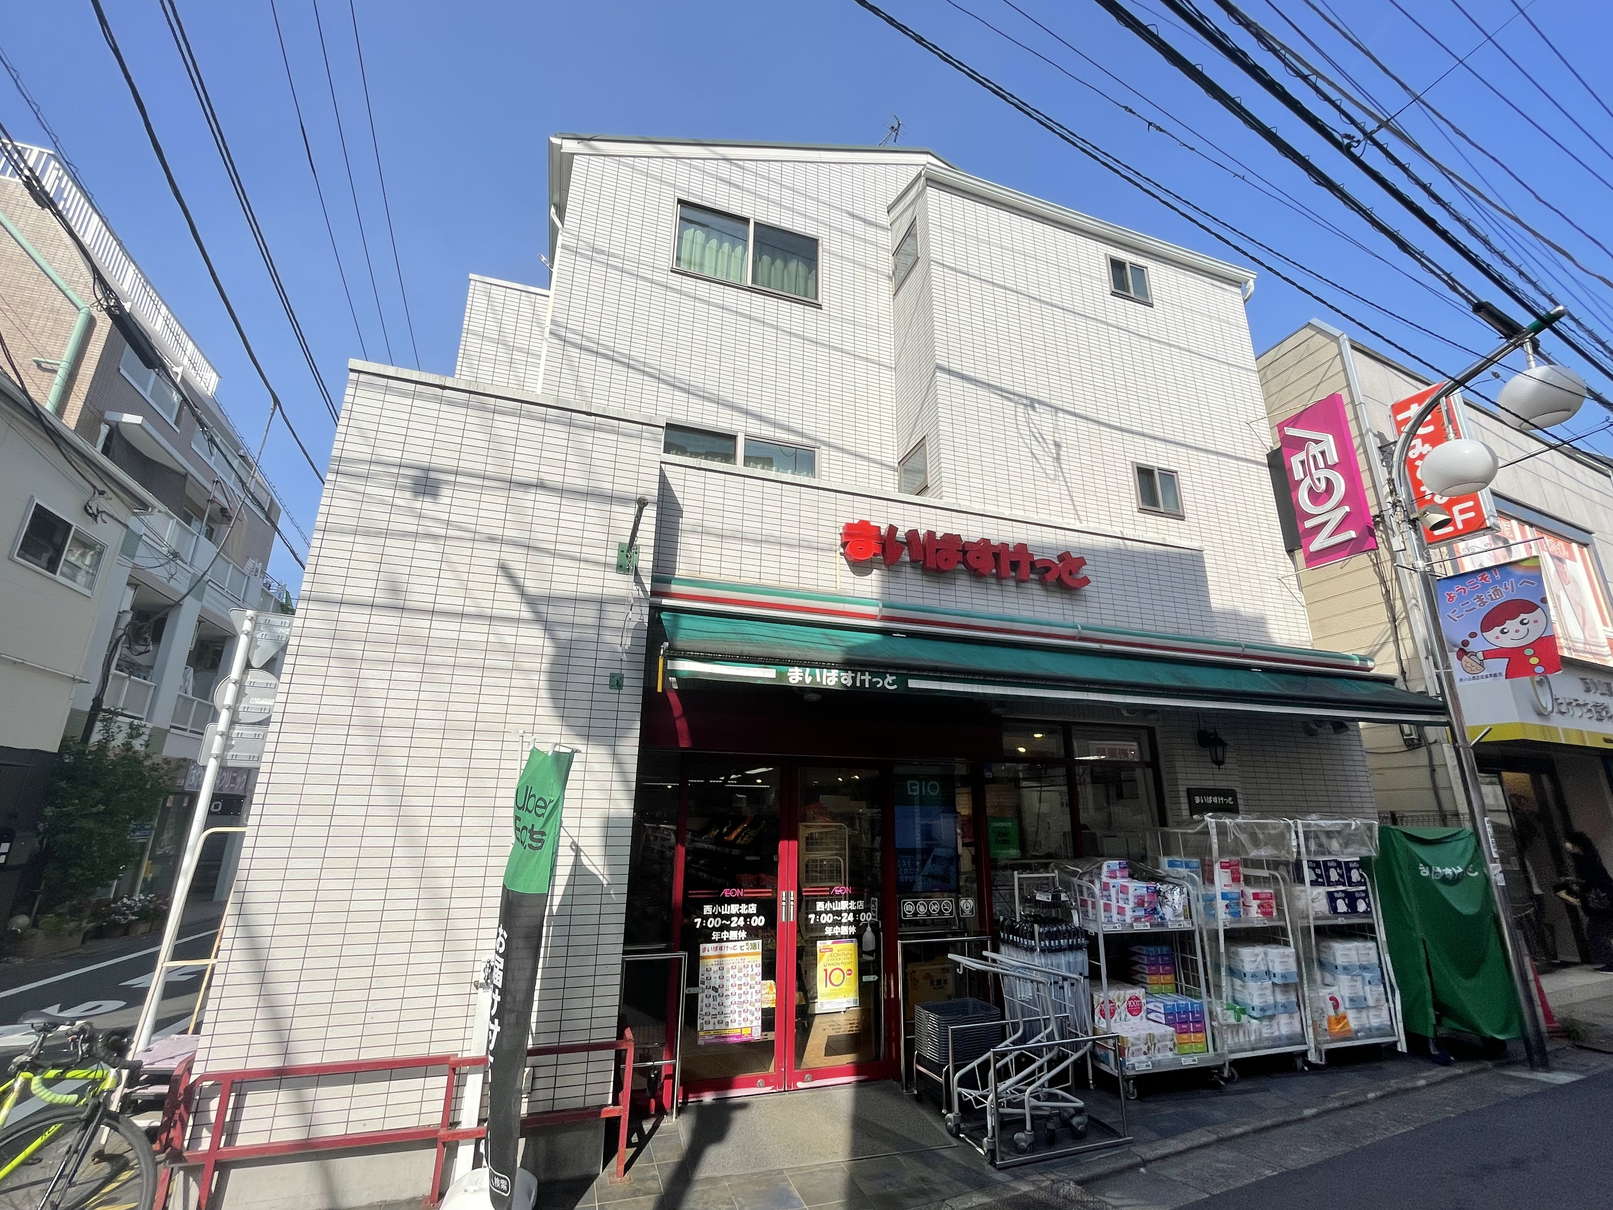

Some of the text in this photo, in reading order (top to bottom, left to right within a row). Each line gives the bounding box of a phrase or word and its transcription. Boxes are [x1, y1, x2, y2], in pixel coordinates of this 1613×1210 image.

[840, 519, 1091, 590] まいばすけっと
[1447, 579, 1537, 622] にこま通りへ
[787, 667, 898, 690] まいばすけっと
[515, 784, 554, 817] Uber
[703, 903, 757, 915] 西小山駅北店
[816, 900, 865, 911] 西小山駅北店
[823, 967, 845, 988] 10
